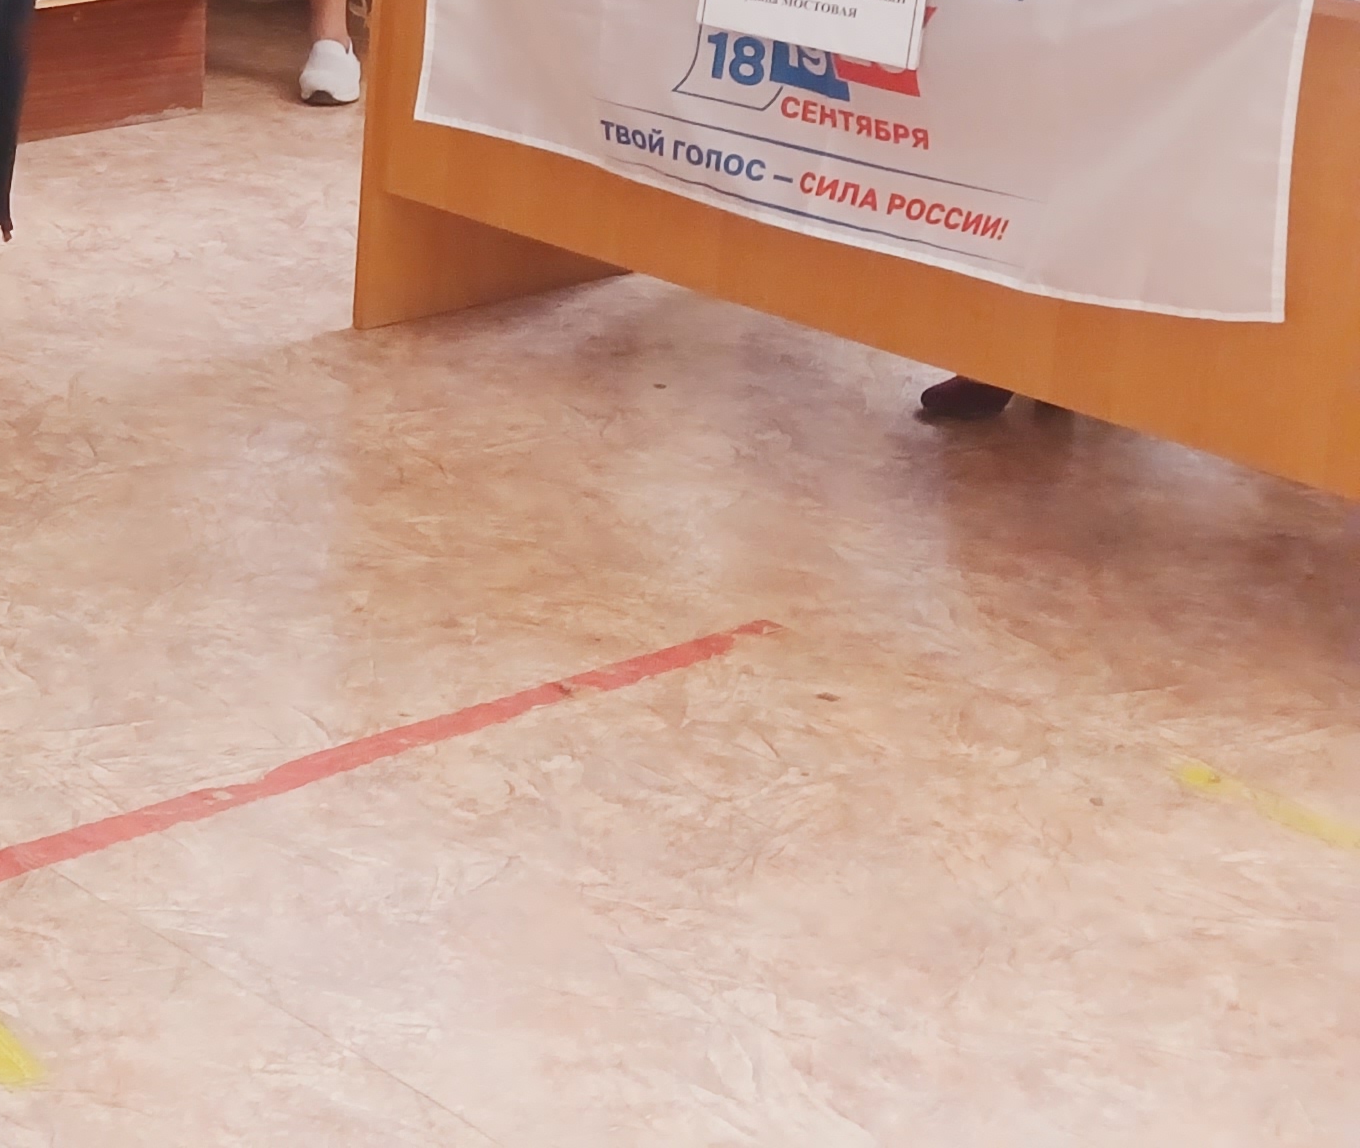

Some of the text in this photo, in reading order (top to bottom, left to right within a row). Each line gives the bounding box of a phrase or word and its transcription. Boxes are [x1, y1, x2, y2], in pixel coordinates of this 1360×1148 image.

[706, 31, 766, 87] 18
[779, 95, 930, 151] СЕНТЯБРЯ
[599, 119, 665, 158] ТВОЙ
[672, 139, 767, 183] ГОЛОС
[798, 170, 879, 212] СИЛА
[886, 192, 1010, 242] РОССИИ!
